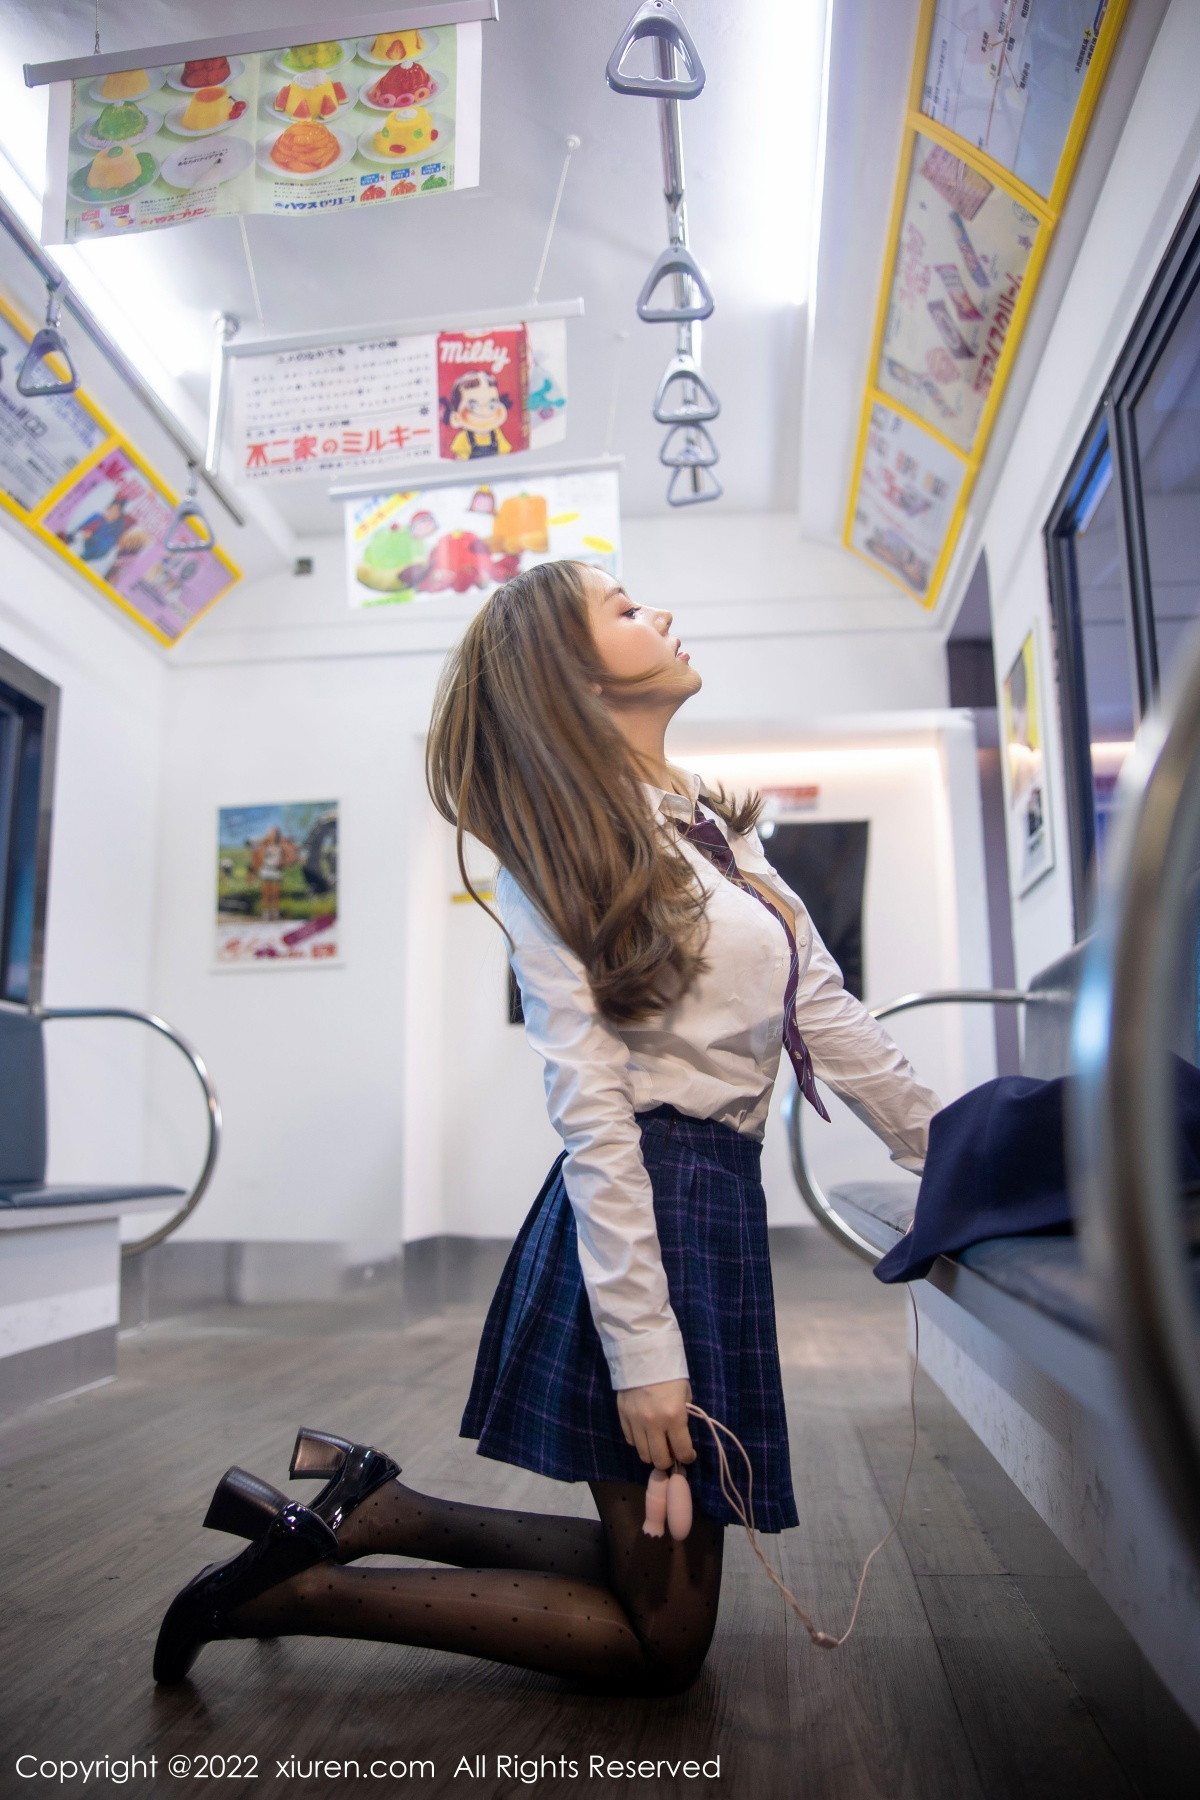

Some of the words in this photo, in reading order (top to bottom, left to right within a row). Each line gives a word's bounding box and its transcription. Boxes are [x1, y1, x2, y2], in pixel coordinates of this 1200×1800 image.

[439, 339, 511, 373] Milky
[245, 424, 431, 468] 不二家のミルキー
